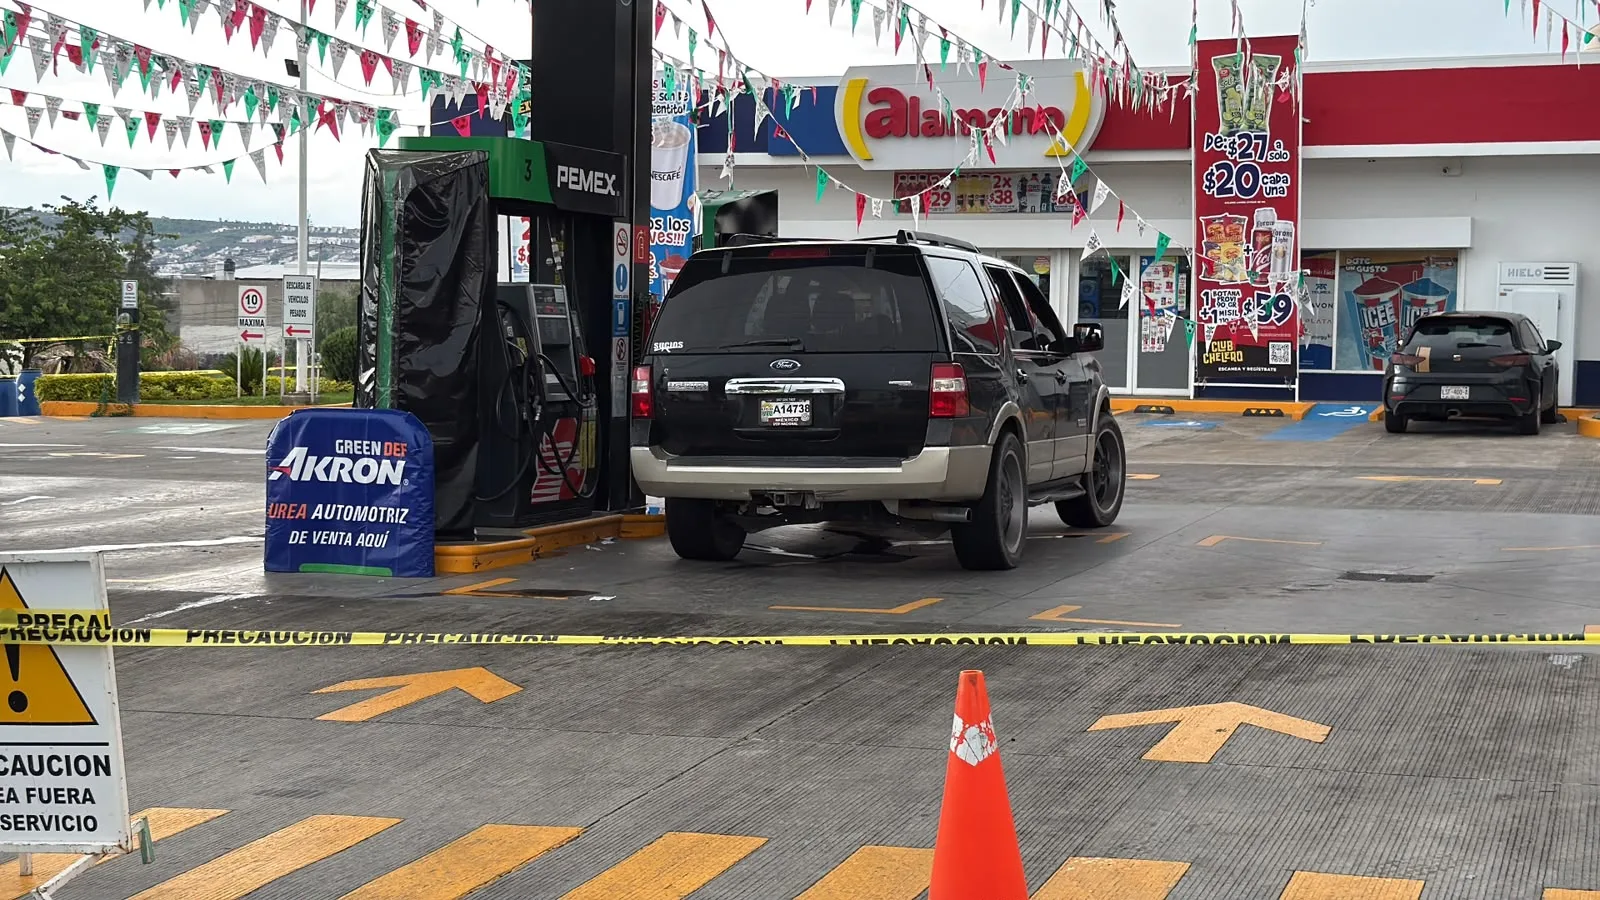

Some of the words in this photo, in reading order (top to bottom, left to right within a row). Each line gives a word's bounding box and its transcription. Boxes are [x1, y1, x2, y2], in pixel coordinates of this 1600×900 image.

[1227, 132, 1268, 161] $27
[1268, 151, 1289, 160] solo
[524, 158, 532, 182] 3
[557, 165, 616, 196] PEMEX
[1204, 161, 1260, 198] $20
[989, 190, 1013, 205] $38
[668, 217, 690, 232] los
[650, 231, 684, 245] ves!!!
[1356, 265, 1388, 273] GUSTO
[1507, 268, 1542, 277] HIELO
[245, 294, 258, 305] 10
[240, 319, 265, 328] MAXIMA
[1361, 302, 1396, 329] ICEE
[1211, 340, 1233, 352] CLUB
[776, 360, 793, 369] Ford
[773, 403, 810, 414] A14738
[335, 439, 381, 456] GREEN
[383, 441, 408, 457] DEF
[268, 446, 406, 486] AKRON
[268, 502, 307, 519] UREA
[311, 503, 409, 524] AUTOMOTRIZ
[288, 530, 308, 545] DE
[312, 531, 352, 546] VENTA
[355, 530, 390, 548] AQUÍ
[0, 754, 112, 776] CAUCION
[0, 787, 20, 804] EA
[25, 787, 97, 805] FUERA
[0, 814, 98, 832] SERVICIO
